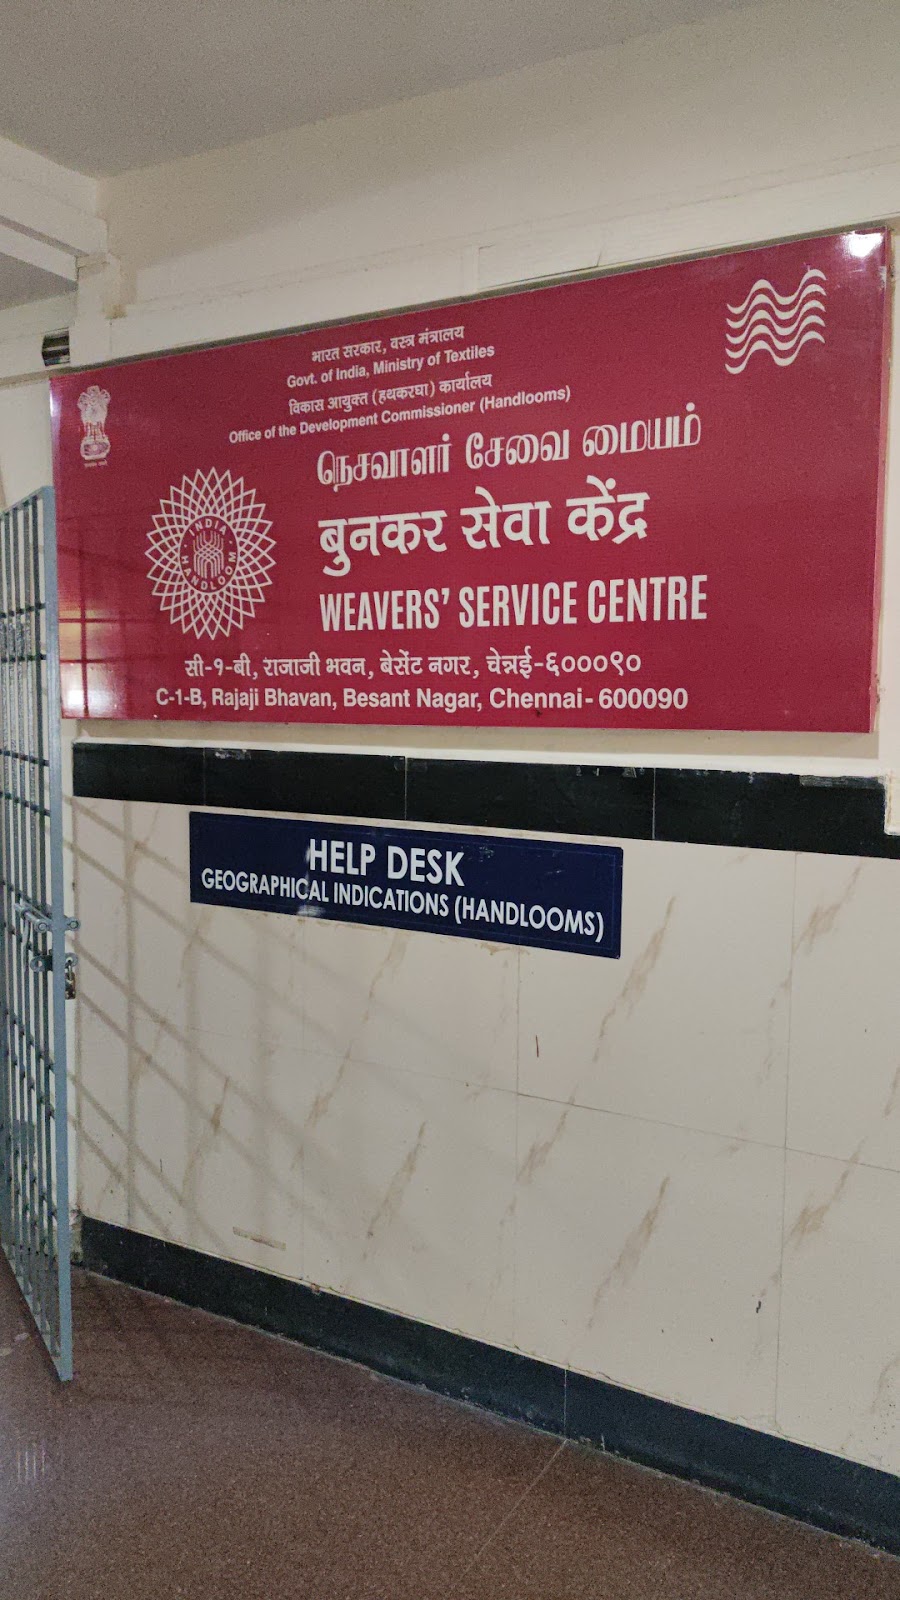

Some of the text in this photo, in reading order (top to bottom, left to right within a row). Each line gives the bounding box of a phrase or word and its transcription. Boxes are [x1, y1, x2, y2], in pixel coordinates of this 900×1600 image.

[287, 344, 495, 388] Govt. of India, Ministry of Textiles
[311, 325, 465, 364] भारत सरकार, वस्त्र मंत्रालय
[229, 385, 571, 444] Office of the Development Commissioner (Handlooms)
[289, 371, 493, 416] विकास आयुक्त (हथकरघा) कार्यालय
[316, 402, 701, 492] நெசவாளர் சேவை மையம்
[189, 518, 227, 537] INDIA
[317, 474, 651, 577] बुनकर सेवा केंद्र
[181, 551, 237, 590] HANDLOOM
[459, 581, 578, 629] SERVICE
[588, 574, 708, 624] CENTRE
[263, 651, 321, 677] राजाजी
[326, 656, 375, 680] भवन,
[379, 649, 423, 675] बेसेंट
[428, 655, 480, 679] नगर,
[156, 687, 207, 709] C-1-B,
[211, 688, 260, 710] Rajaji
[264, 688, 337, 710] Bhavan,
[343, 688, 411, 708] Besant
[417, 688, 482, 713] Nagar,
[308, 838, 465, 888] HELP DESK
[201, 868, 605, 943] GEOGRAPHICAL INDICATIONS (HANDLOOMS)
